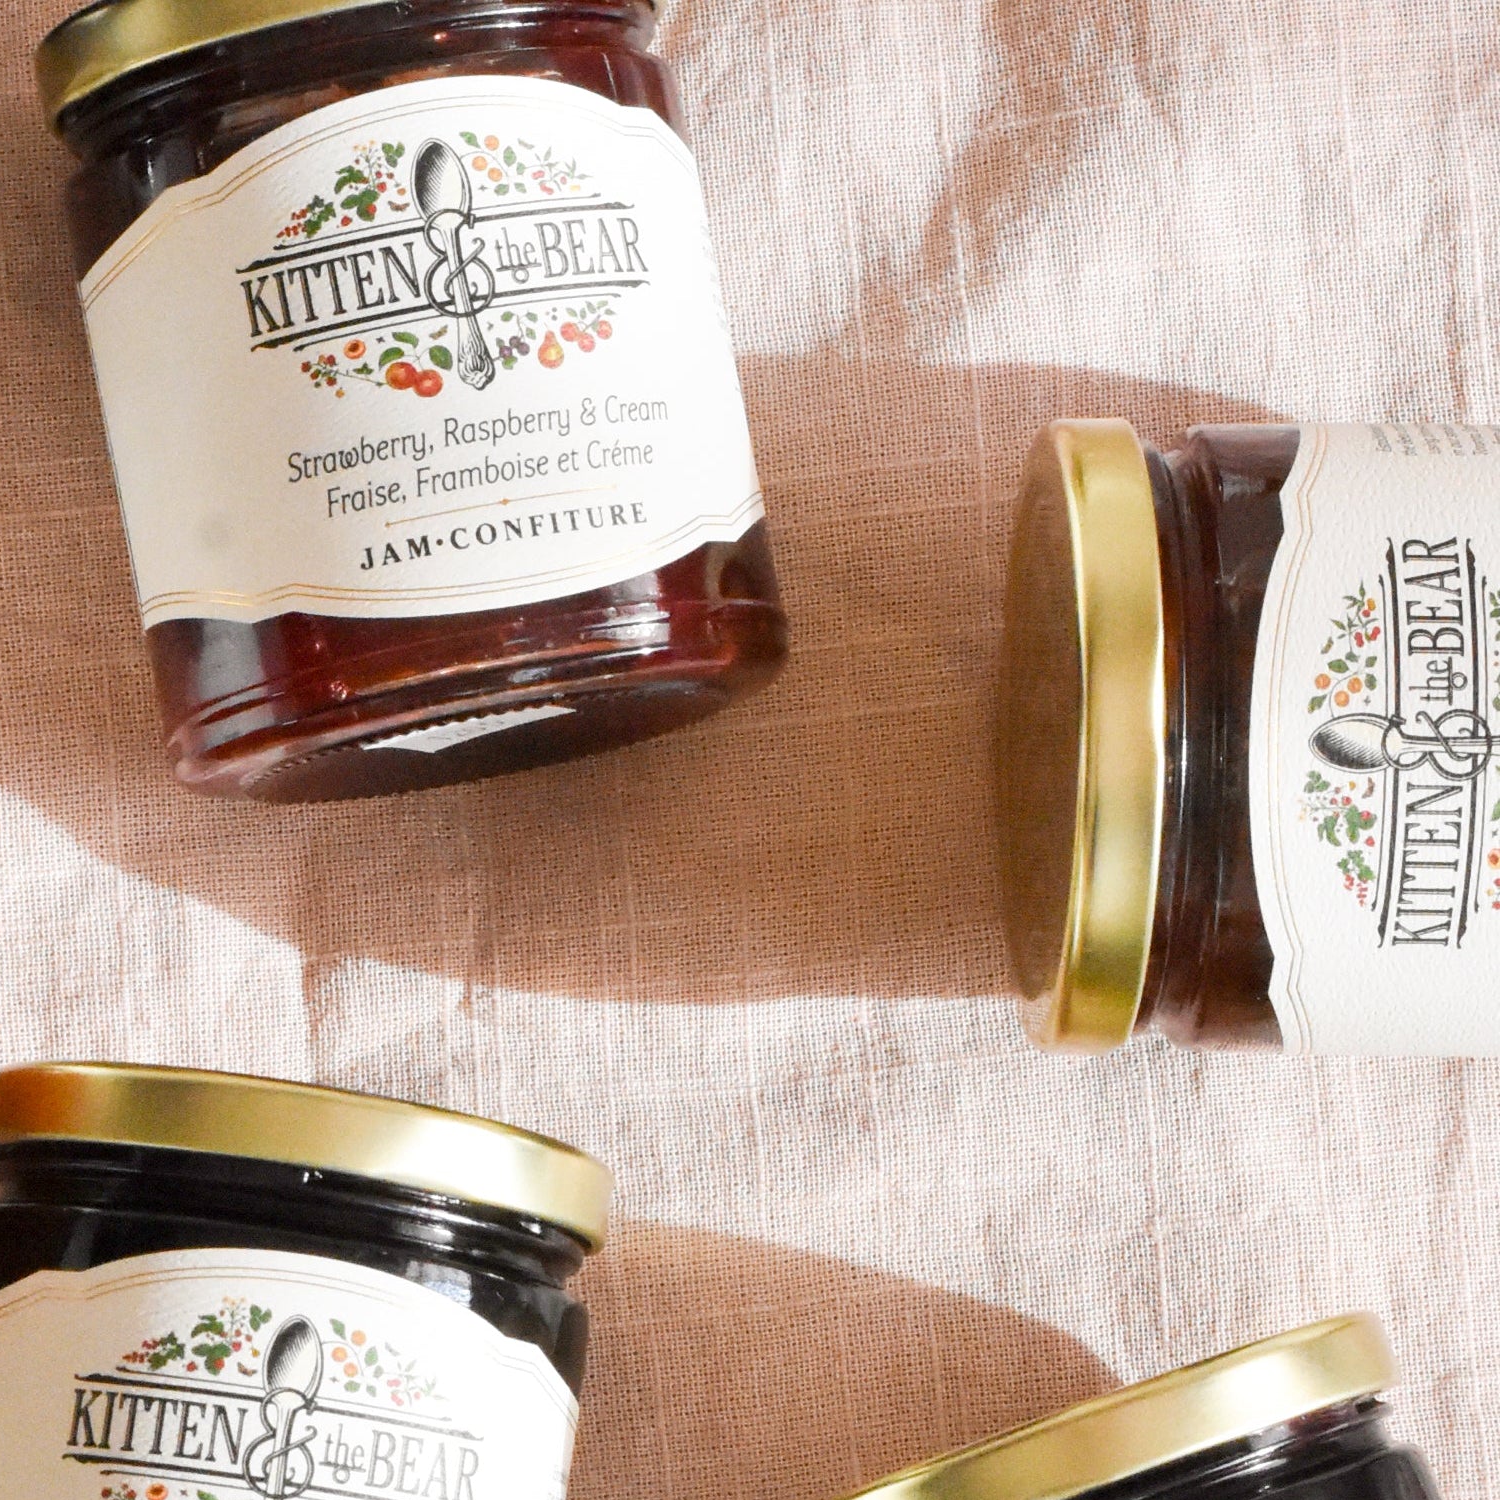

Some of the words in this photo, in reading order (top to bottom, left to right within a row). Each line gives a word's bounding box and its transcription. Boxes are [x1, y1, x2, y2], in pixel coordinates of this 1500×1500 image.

[239, 242, 422, 337] KITTEN
[494, 226, 541, 284] the
[537, 216, 649, 278] BEAR
[287, 432, 434, 484] Strawberry,
[443, 408, 571, 448] Raspberry
[579, 397, 597, 427] &
[604, 394, 669, 424] Cream
[326, 480, 407, 519] Fraise,
[416, 455, 549, 498] Framboise
[557, 449, 580, 474] et
[586, 439, 653, 470] Créme
[1402, 536, 1465, 657] BEAR
[1392, 784, 1463, 948] KITTEN
[66, 1387, 248, 1466] KITTEN
[317, 1423, 366, 1484] the
